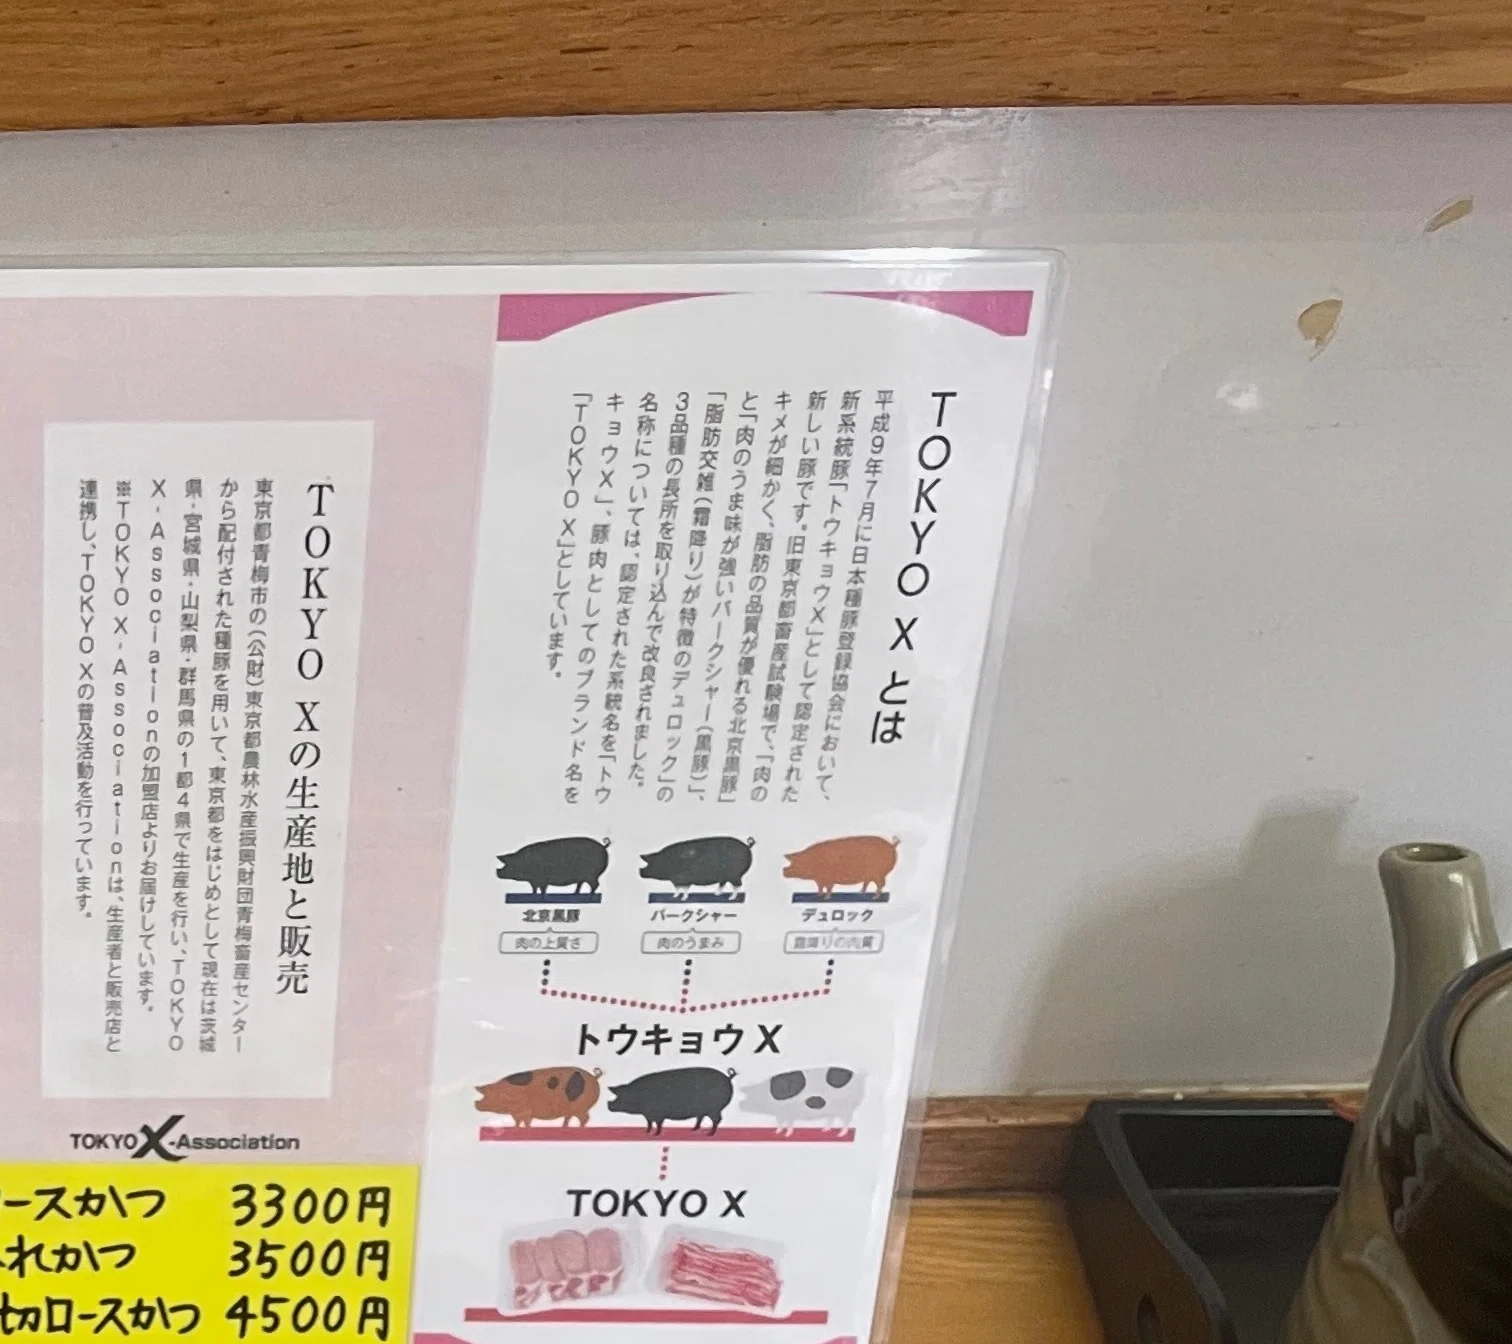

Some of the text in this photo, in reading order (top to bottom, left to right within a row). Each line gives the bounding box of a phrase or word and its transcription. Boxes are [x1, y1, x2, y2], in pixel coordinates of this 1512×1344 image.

[896, 391, 957, 597] TOKYO
[297, 483, 335, 680] TOKYO
[650, 909, 738, 923] バークシャー
[801, 908, 874, 922] デュロック
[231, 1182, 391, 1227] 3300円
[566, 1188, 747, 1218] TOKYO X
[227, 1238, 390, 1281] 3500円
[224, 1295, 389, 1342] 4500円
